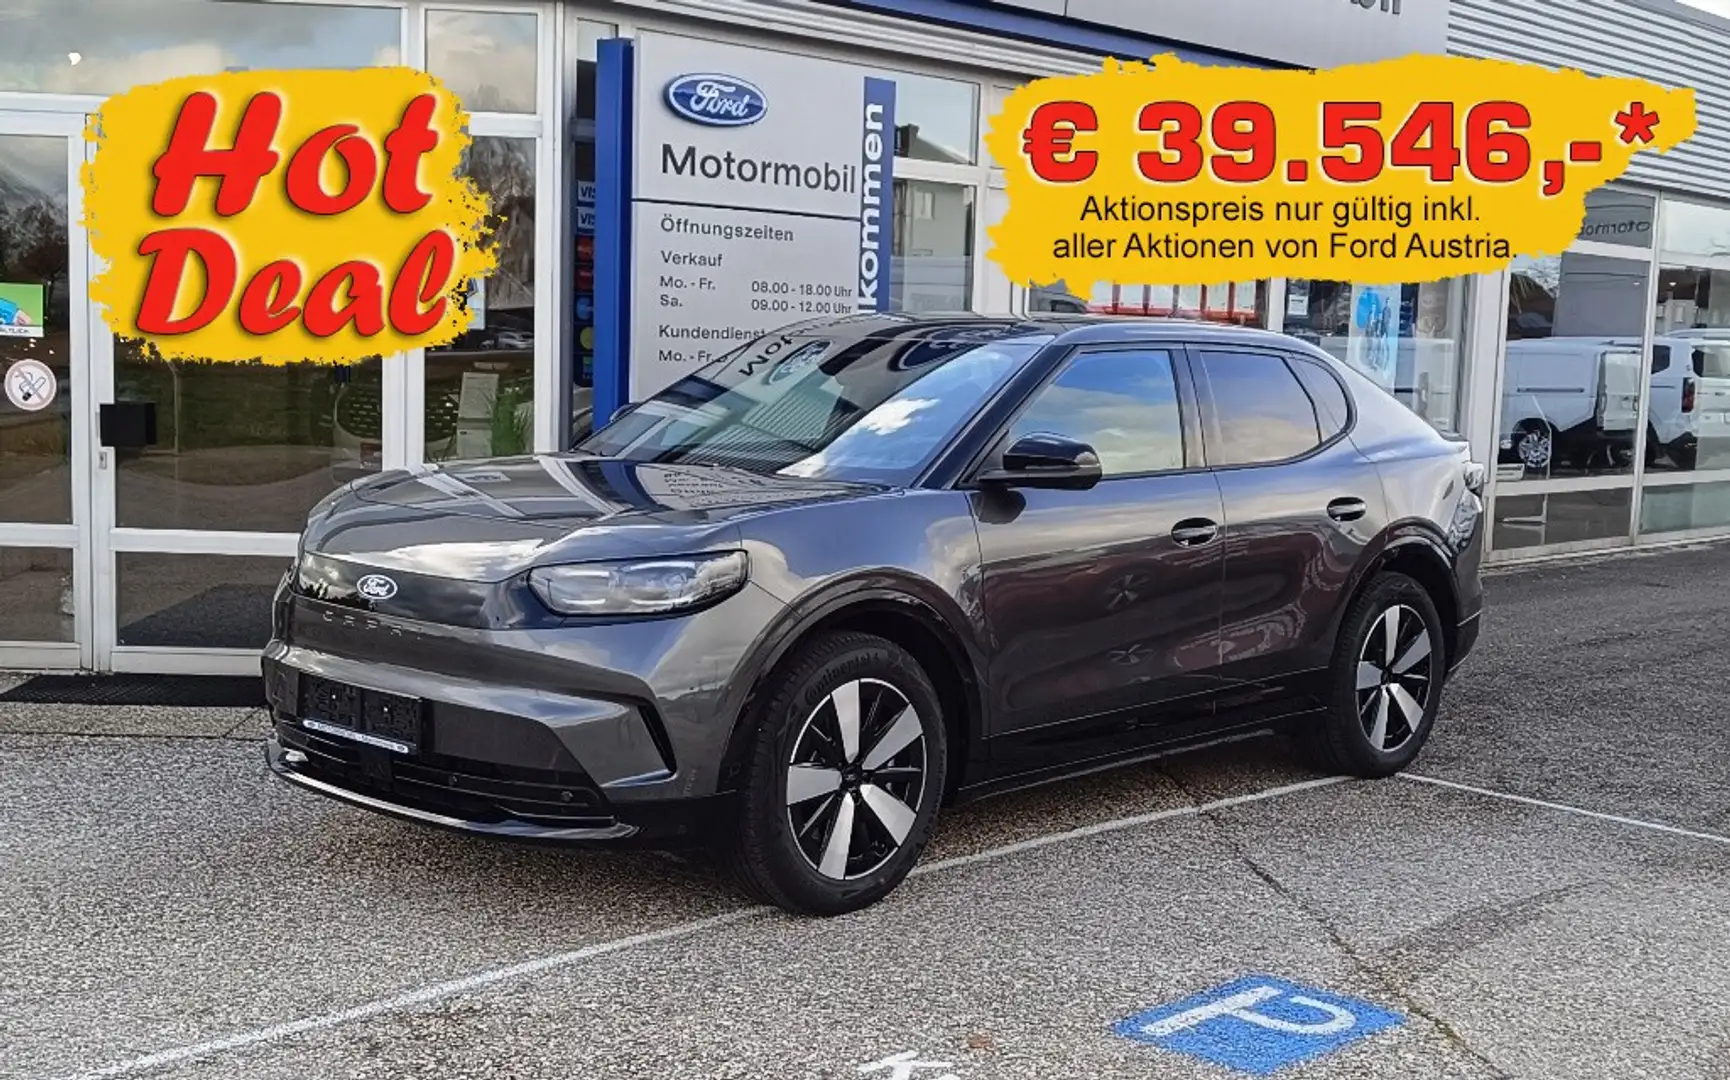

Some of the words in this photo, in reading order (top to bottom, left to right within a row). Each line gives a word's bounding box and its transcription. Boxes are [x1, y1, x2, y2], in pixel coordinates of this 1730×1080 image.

[689, 81, 751, 117] Ford
[661, 143, 857, 194] Motormobil
[660, 212, 795, 242] Öffnungszeiten
[660, 250, 723, 267] Verkauf
[660, 276, 688, 289] Mo.
[699, 277, 716, 291] Fr.
[751, 280, 789, 294] 08.00
[799, 283, 832, 298] 18.00
[834, 285, 853, 298] Uhr
[660, 294, 684, 307] Sa.
[751, 299, 789, 312] 09.00
[799, 301, 831, 314] 12.00
[833, 303, 852, 314] Uhr
[658, 350, 687, 363] Mo.
[363, 578, 390, 596] Ford
